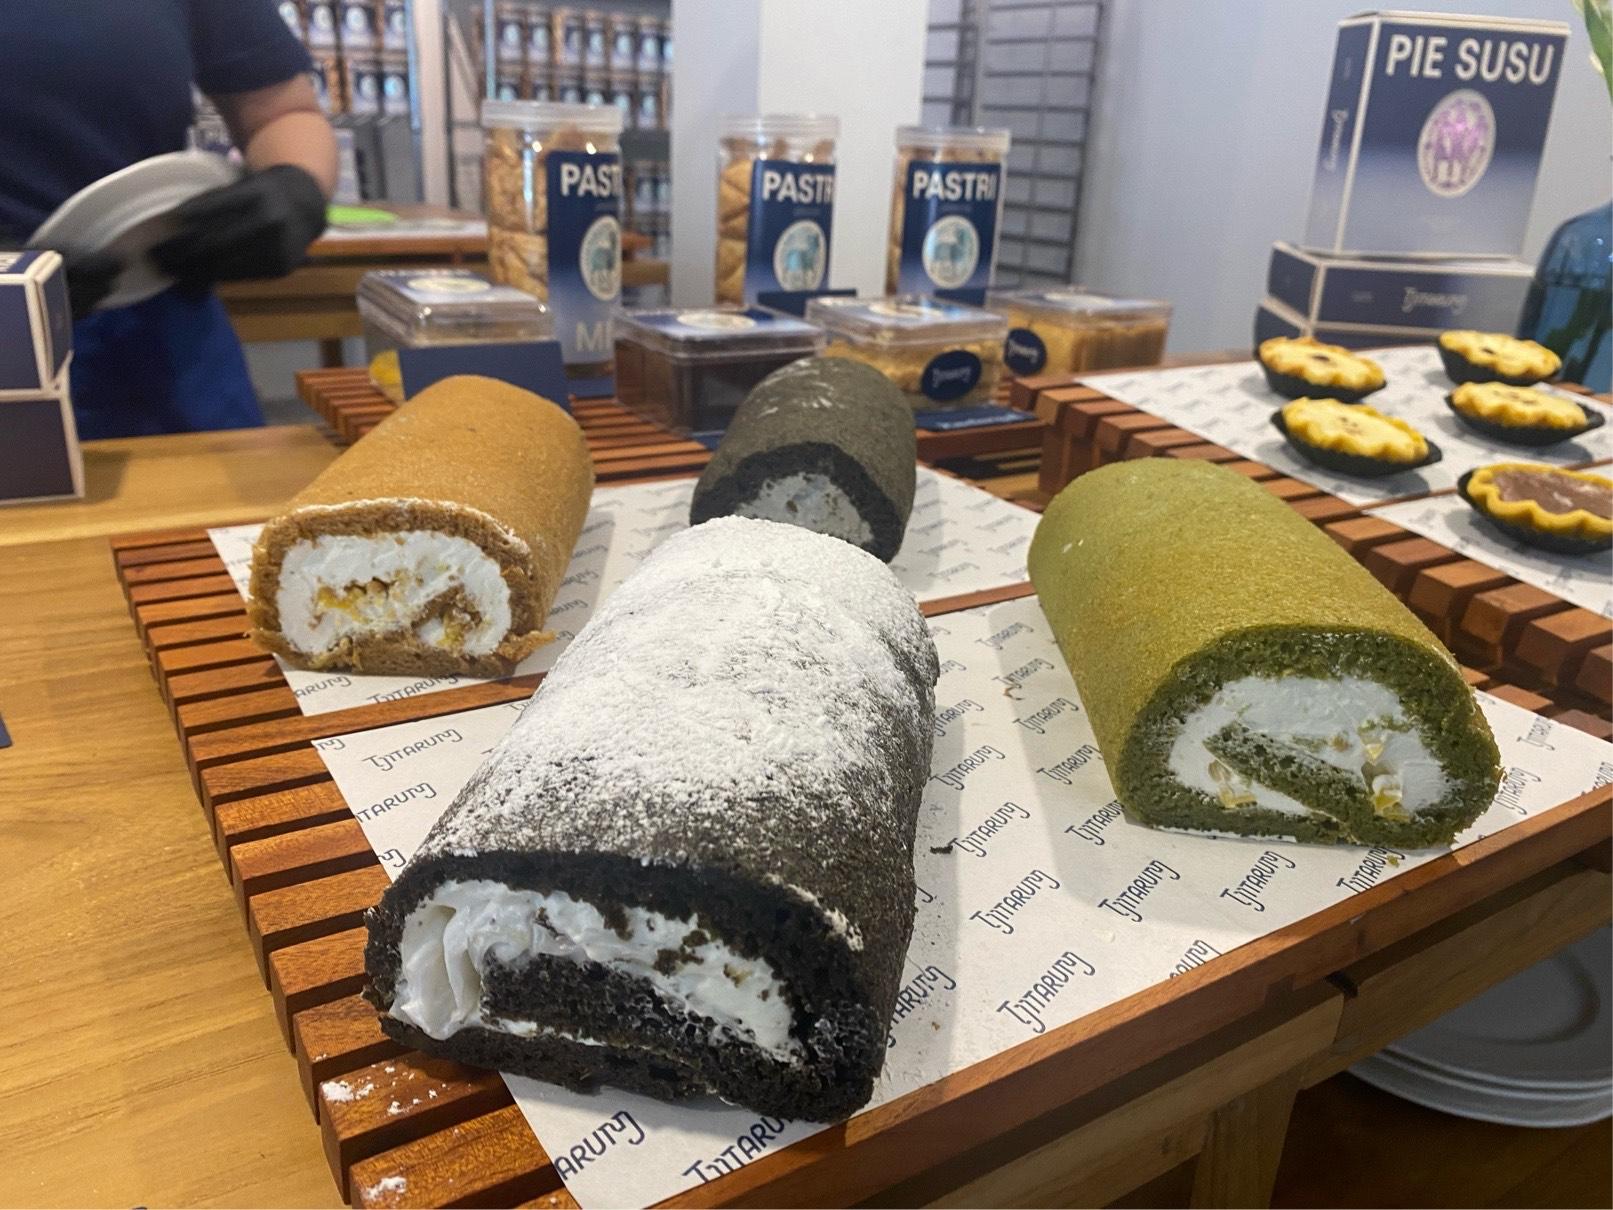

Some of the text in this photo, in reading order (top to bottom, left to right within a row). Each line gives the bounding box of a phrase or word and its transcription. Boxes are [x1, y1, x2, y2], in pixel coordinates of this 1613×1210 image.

[1385, 33, 1555, 85] PIE SUSU
[912, 168, 998, 202] PASTRI
[294, 676, 352, 699] ARUM
[932, 699, 984, 737] JITARUM
[354, 782, 437, 823] ITARUM
[553, 1110, 645, 1181] ARUM
